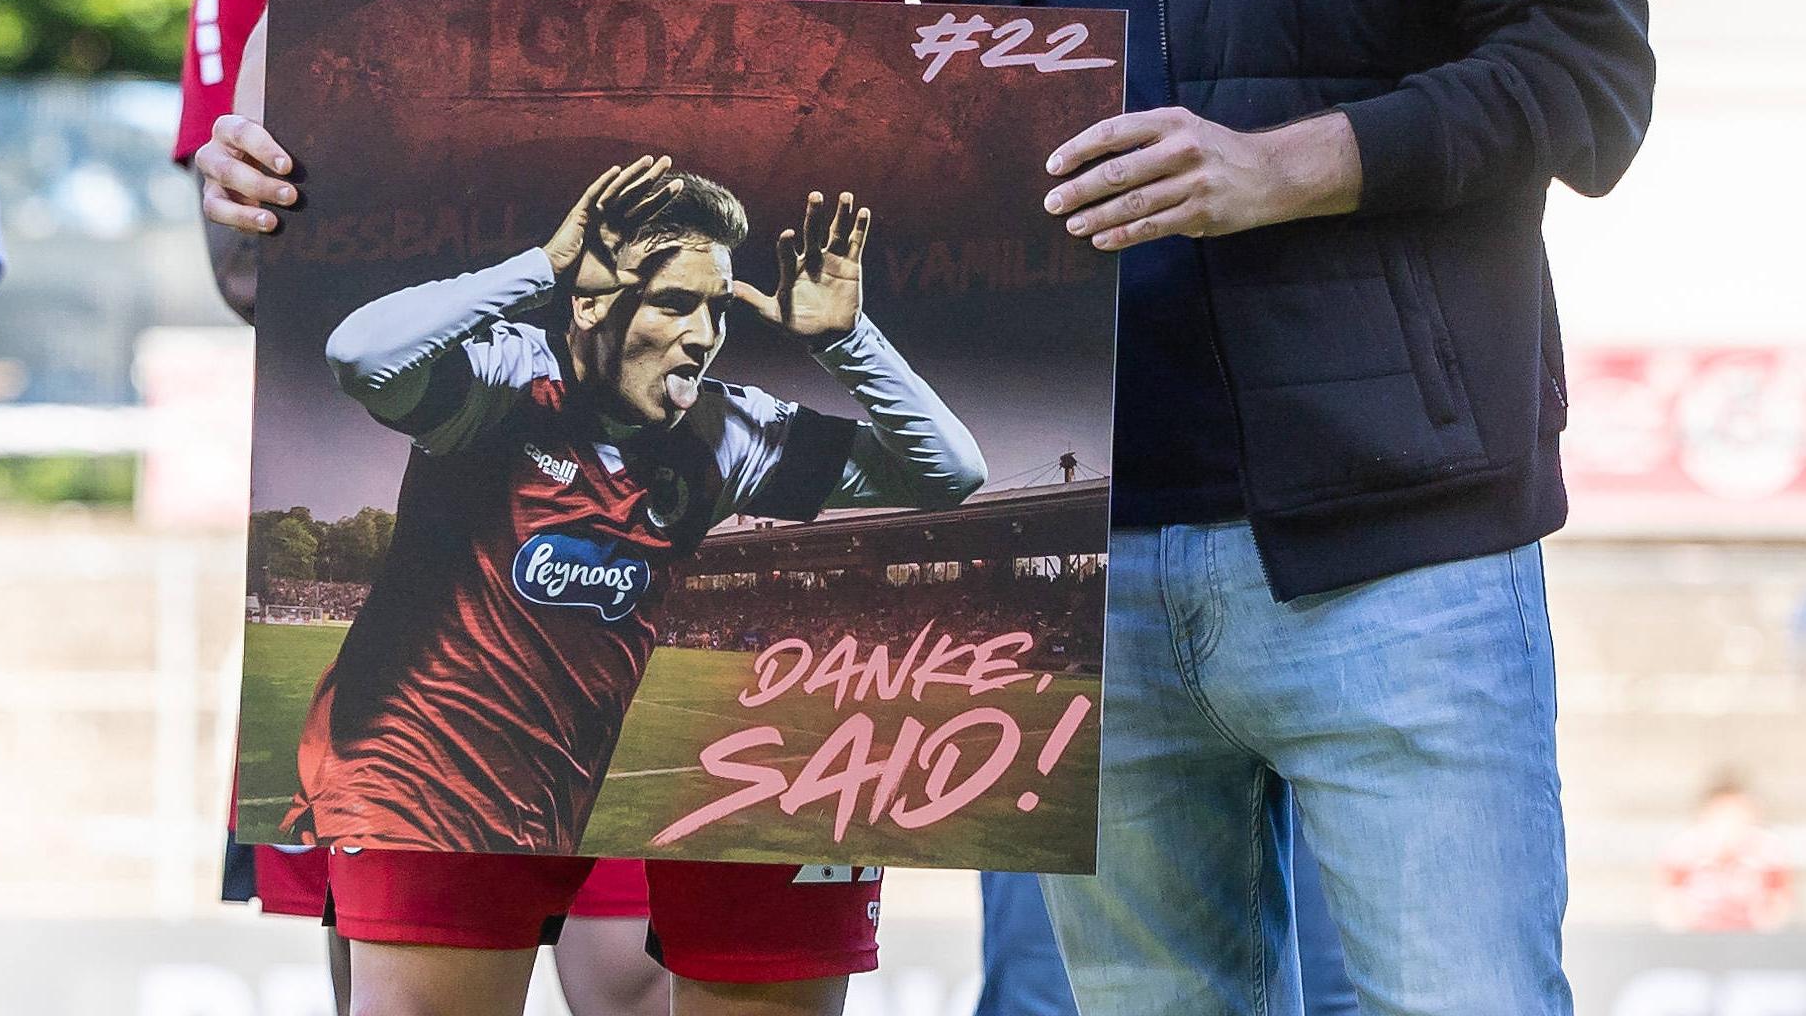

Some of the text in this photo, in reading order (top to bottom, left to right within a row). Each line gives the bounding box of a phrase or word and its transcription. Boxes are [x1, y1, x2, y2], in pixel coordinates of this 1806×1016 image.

[911, 12, 1118, 84] #22
[524, 443, 579, 483] capelli
[738, 618, 1056, 708] DANKE,
[650, 693, 1092, 844] SAID!
